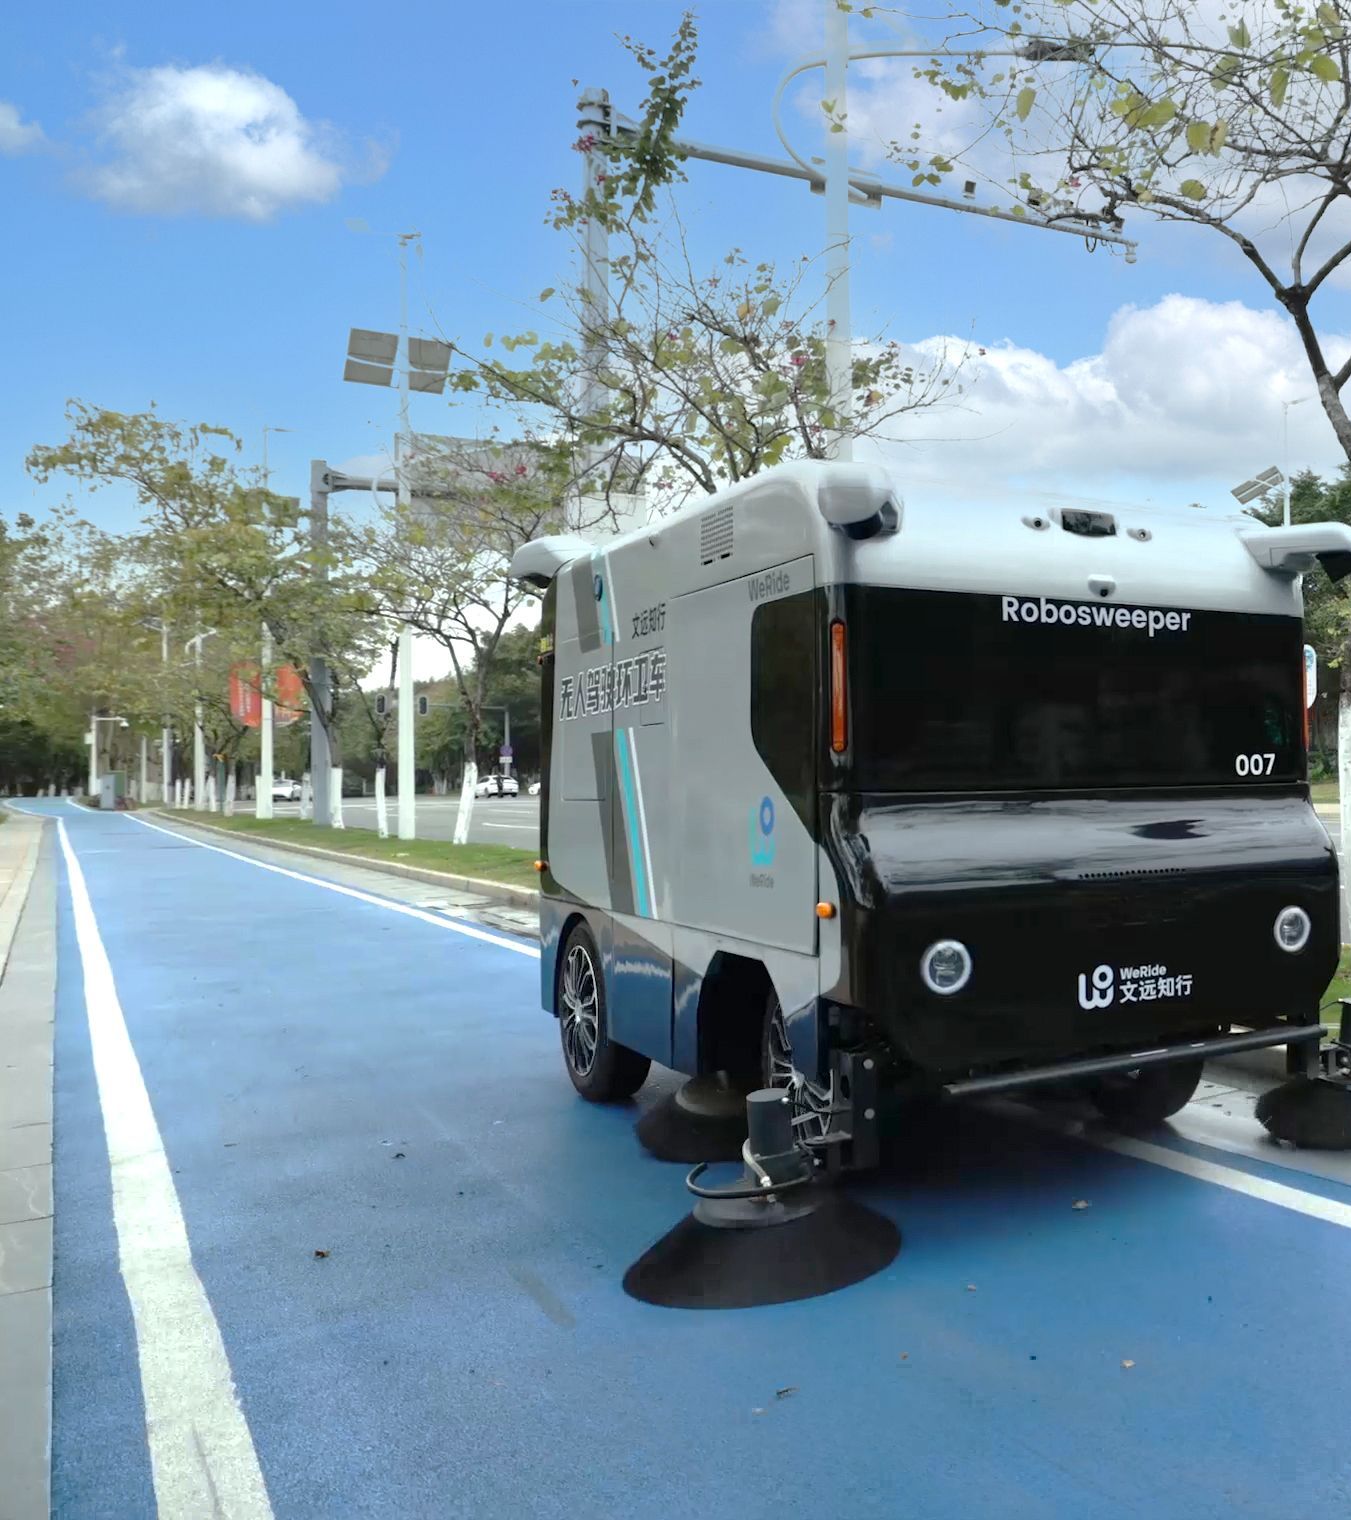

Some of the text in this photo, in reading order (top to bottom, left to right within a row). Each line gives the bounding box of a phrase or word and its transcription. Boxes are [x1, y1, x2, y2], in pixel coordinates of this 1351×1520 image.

[748, 571, 790, 601] WeRide
[632, 602, 666, 639] 文远知行
[1001, 595, 1191, 637] Robosweeper
[559, 651, 666, 722] 无人驾驶环卫车
[1235, 753, 1276, 776] 007
[1120, 964, 1167, 980] WeRide
[1119, 974, 1193, 1004] 文远知行
